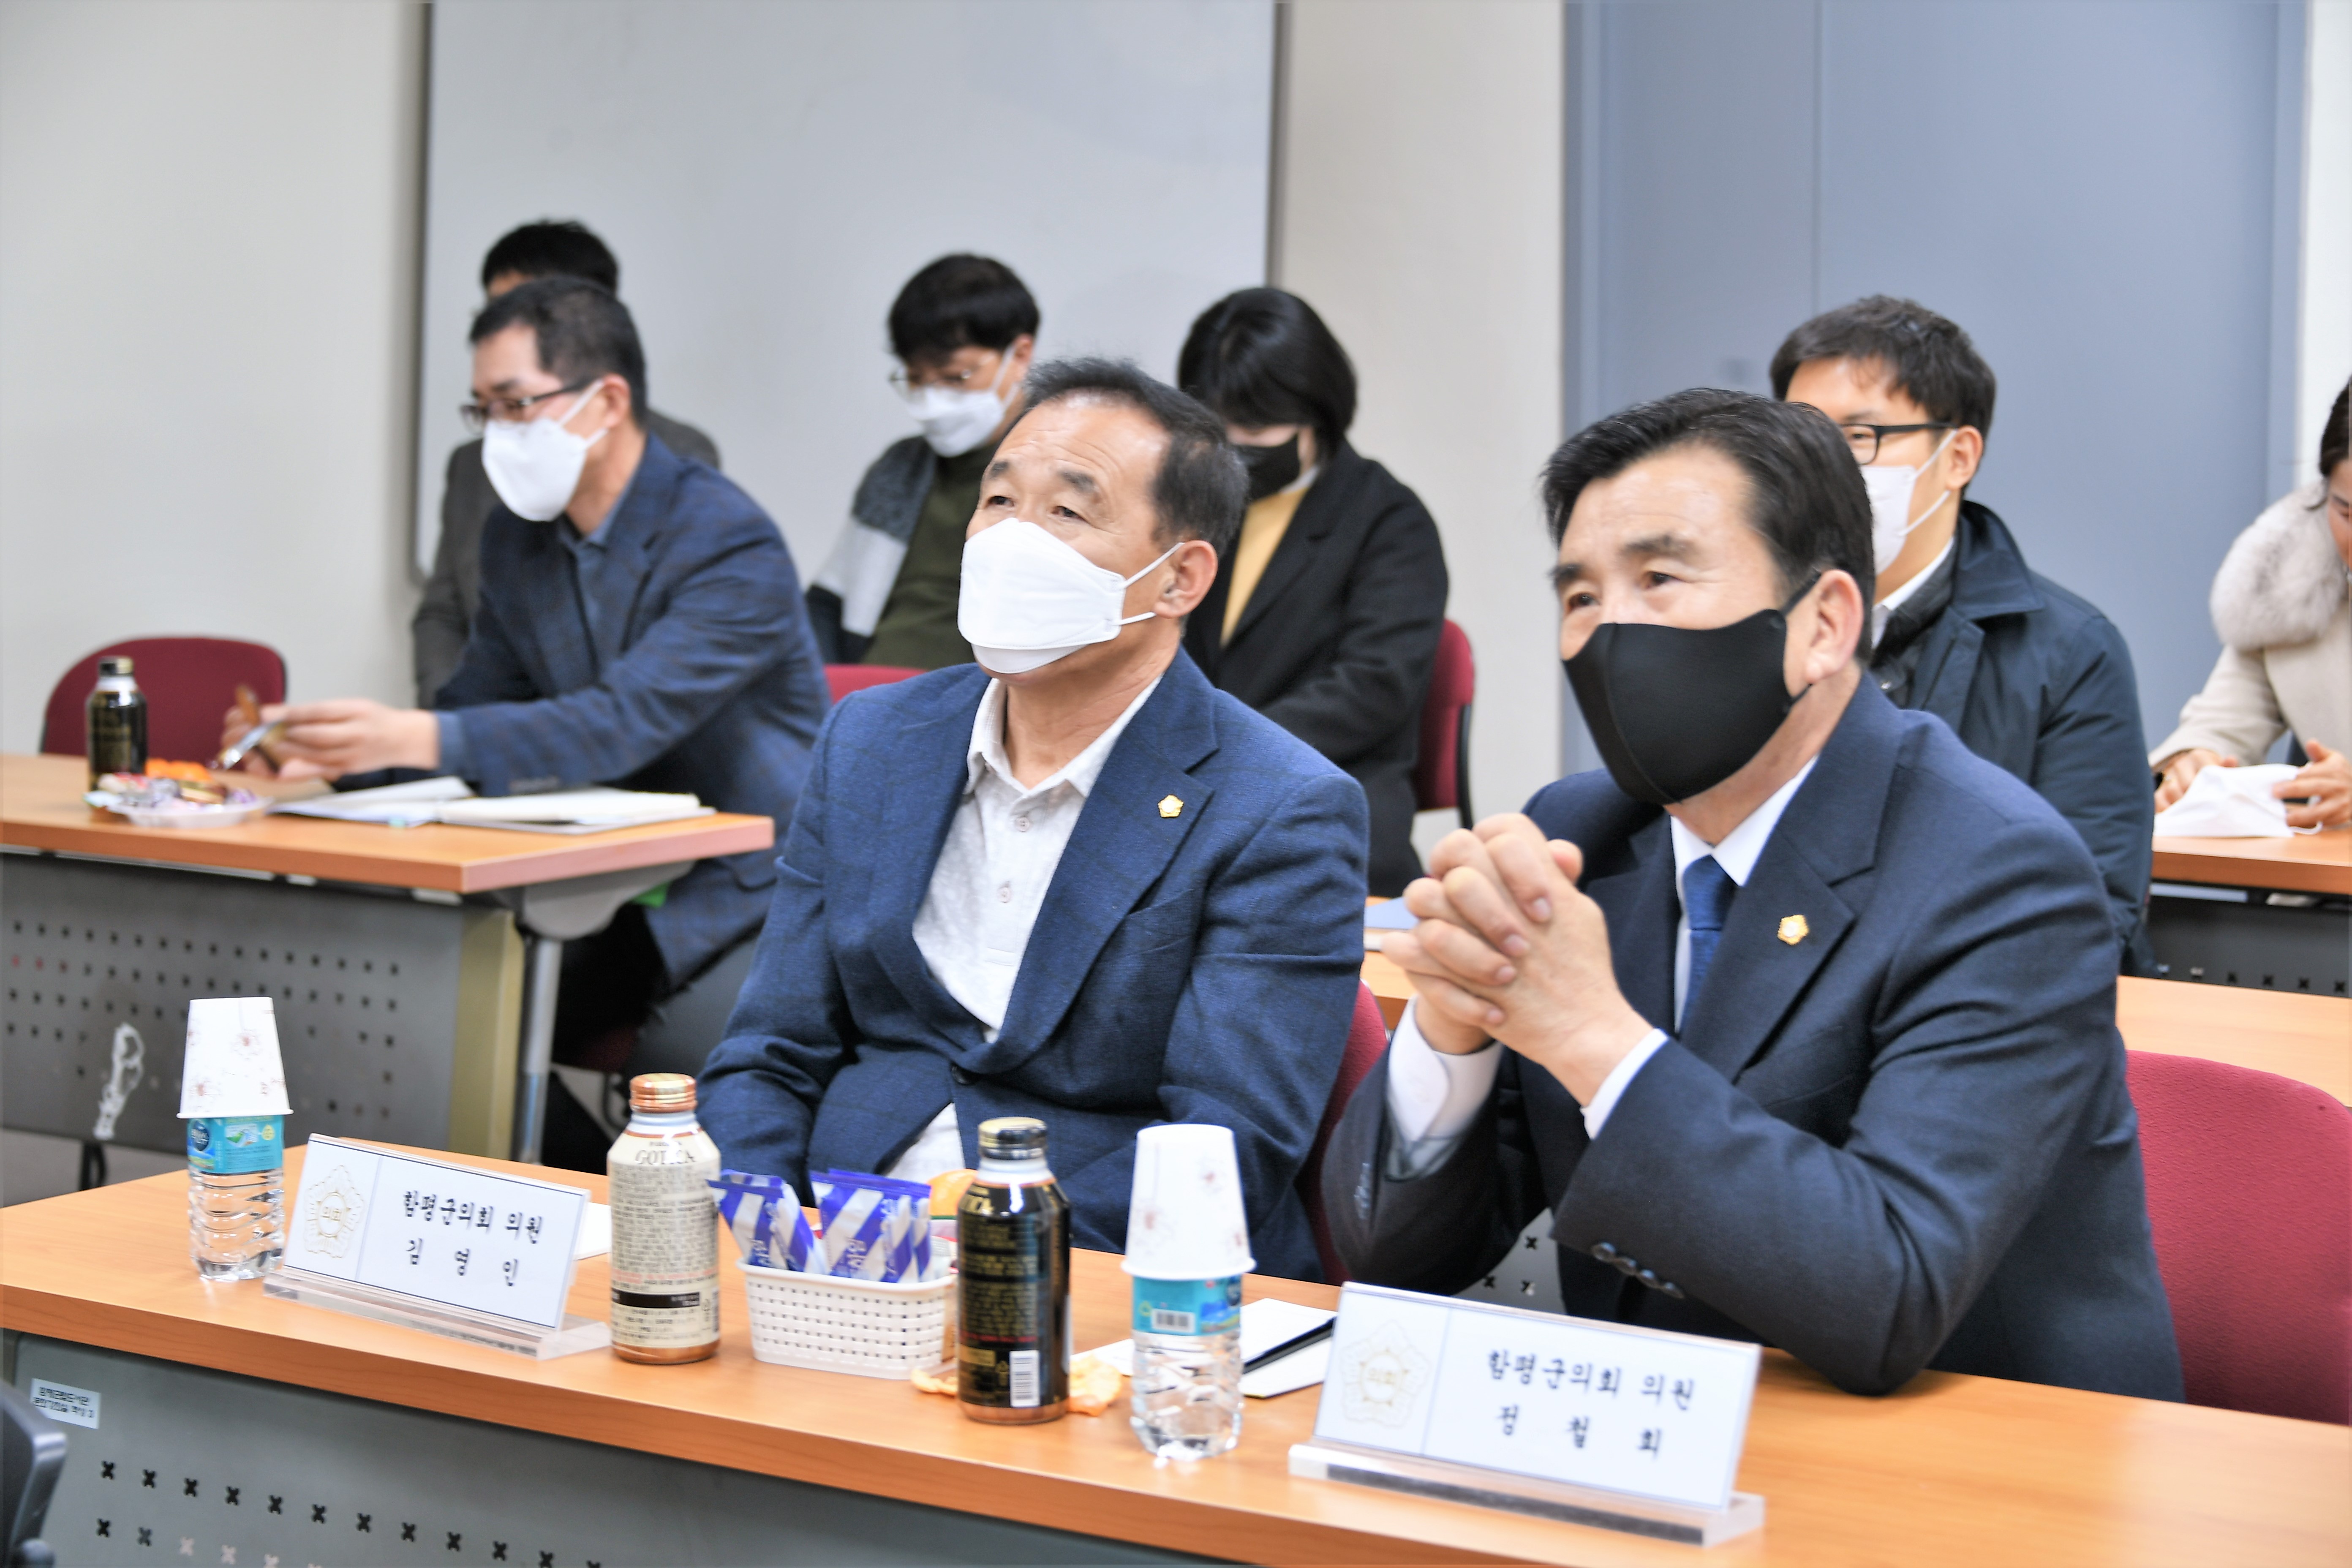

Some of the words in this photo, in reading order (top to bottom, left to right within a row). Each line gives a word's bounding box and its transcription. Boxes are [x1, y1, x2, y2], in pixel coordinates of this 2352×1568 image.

[635, 1149, 697, 1165] GOTCA
[404, 1190, 493, 1234] 함평군의회
[505, 1212, 542, 1244] 의원
[406, 1238, 423, 1265] 김
[455, 1248, 470, 1276] 영
[503, 1258, 518, 1287] 인
[1489, 1350, 1622, 1398] 함평군의회
[1641, 1375, 1694, 1410] 의원
